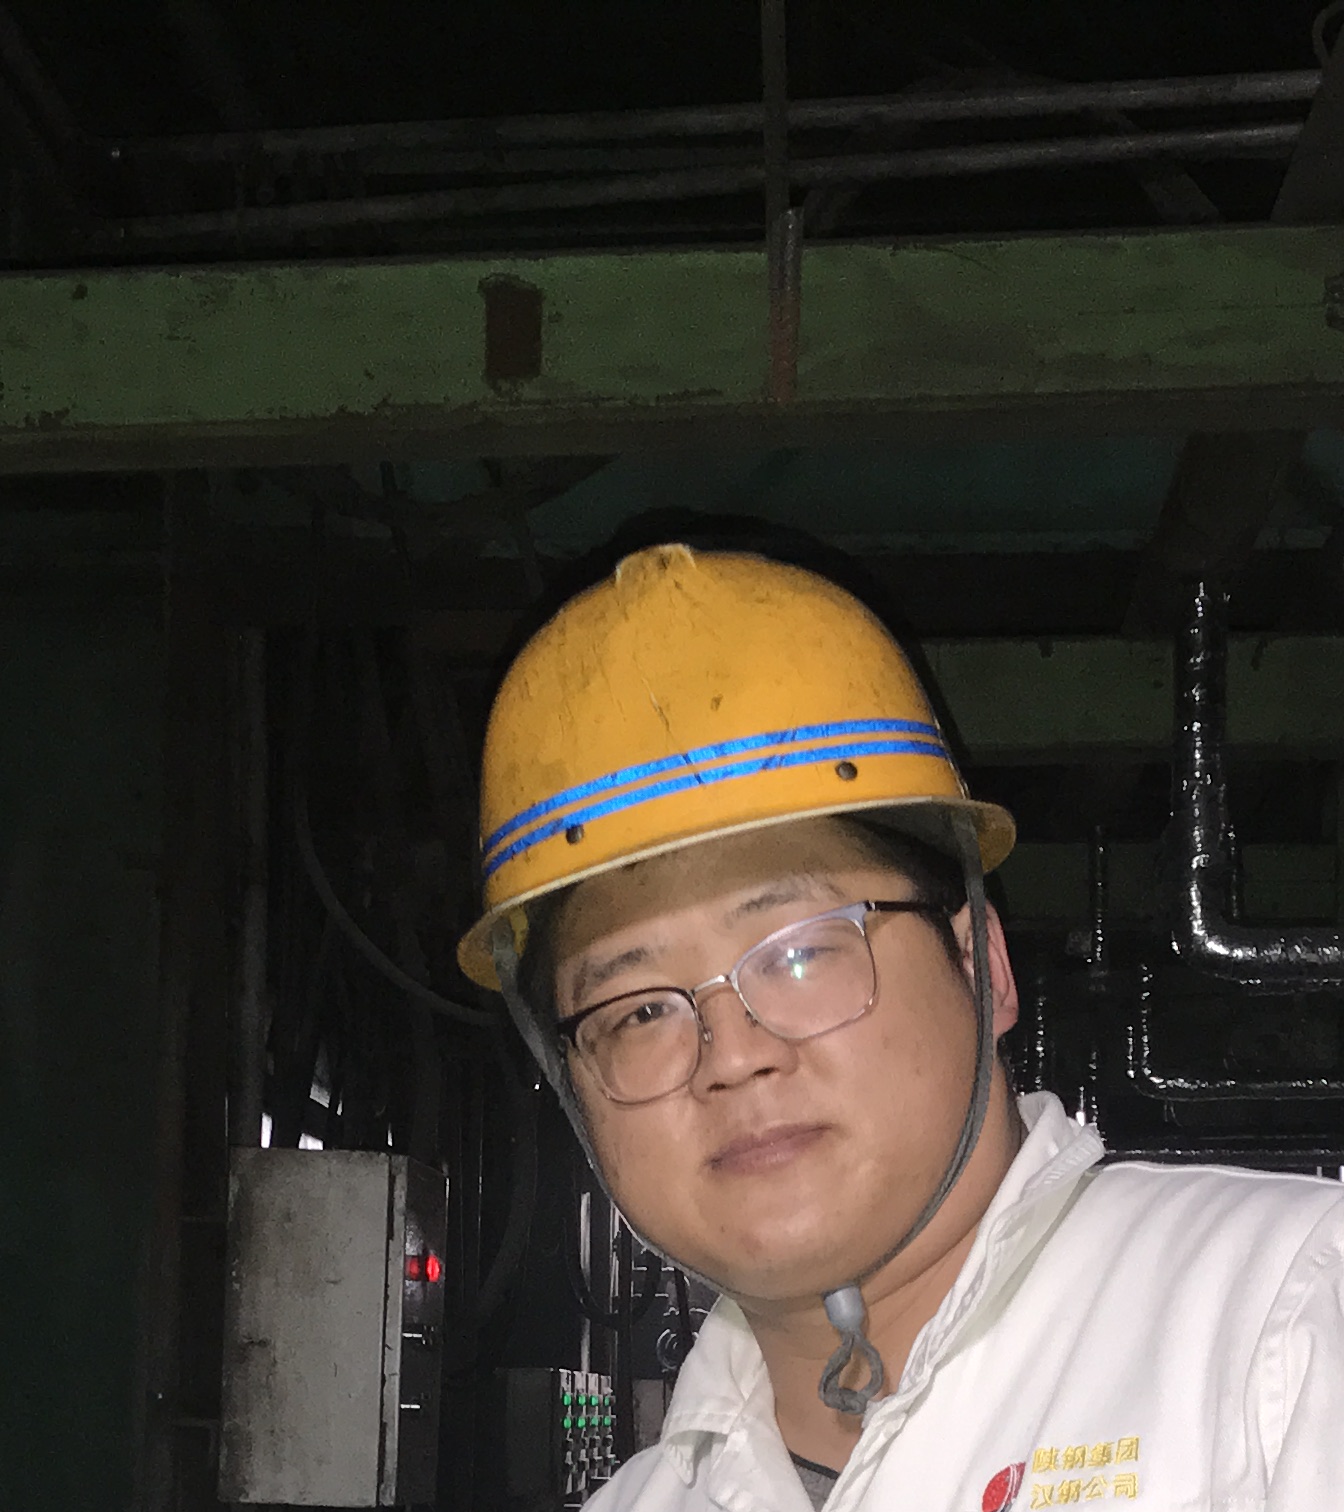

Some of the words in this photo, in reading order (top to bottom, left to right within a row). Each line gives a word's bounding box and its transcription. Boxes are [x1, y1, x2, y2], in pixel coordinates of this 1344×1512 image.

[1031, 1436, 1141, 1474] 陕钢集团
[1030, 1473, 1140, 1510] 汉钢公司
